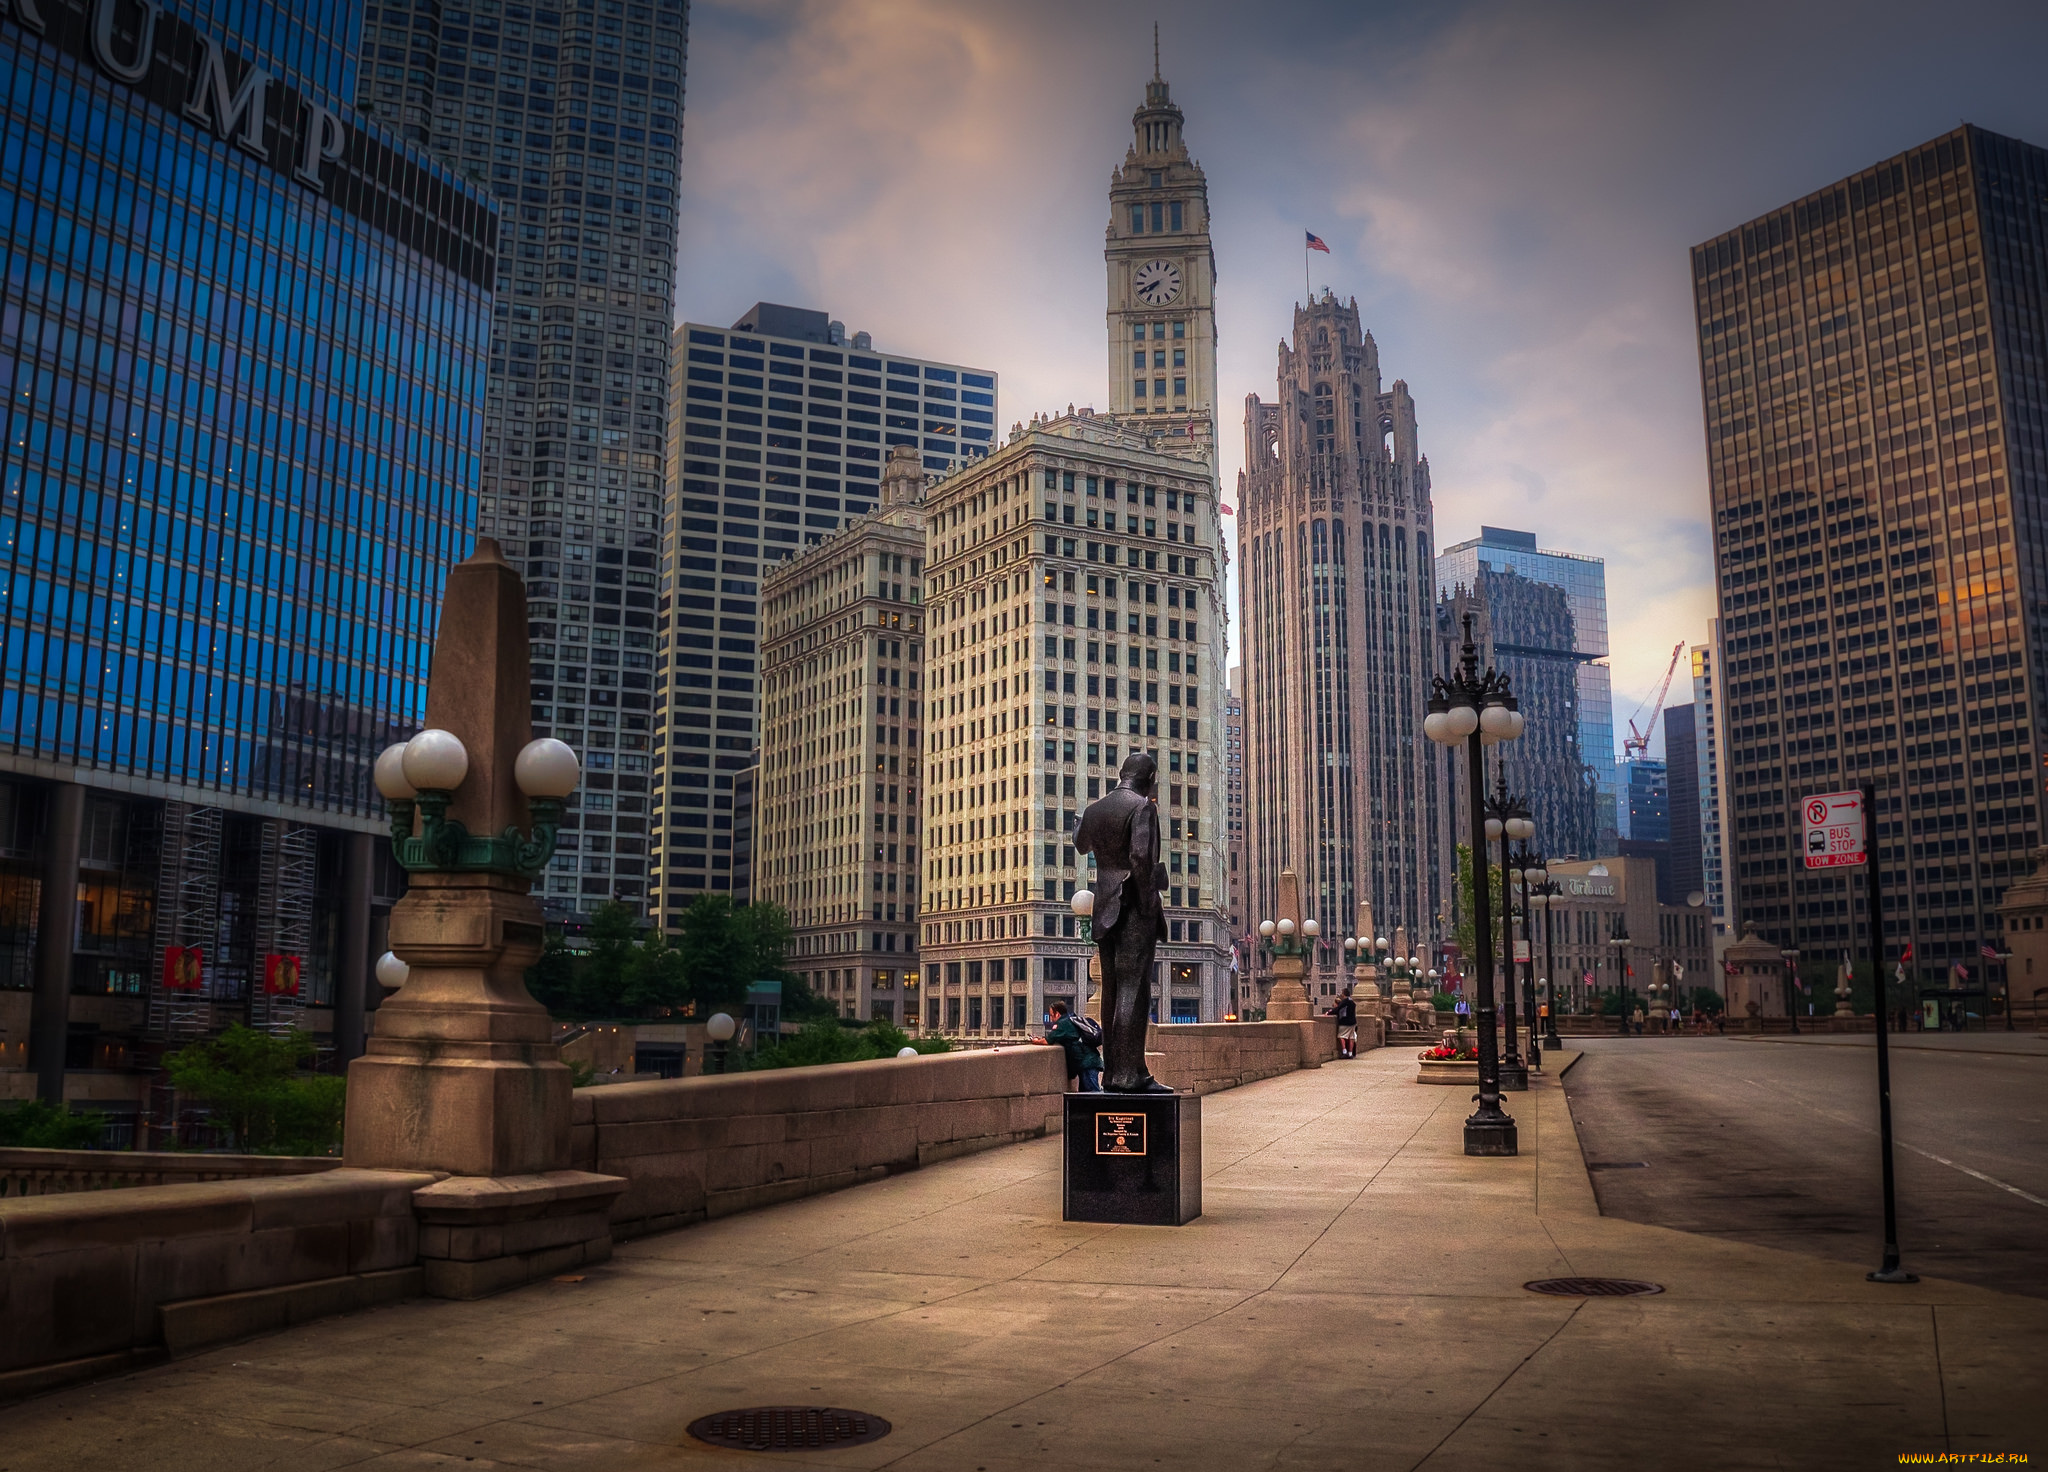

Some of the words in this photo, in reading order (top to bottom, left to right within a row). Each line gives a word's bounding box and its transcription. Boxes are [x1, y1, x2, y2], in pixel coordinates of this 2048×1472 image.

[0, 0, 346, 194] UMP
[1829, 827, 1850, 839] BUS
[1830, 839, 1856, 852] STOP
[1809, 856, 1829, 866] TOW
[1834, 853, 1860, 864] ZONE
[1568, 878, 1616, 896] Tribune
